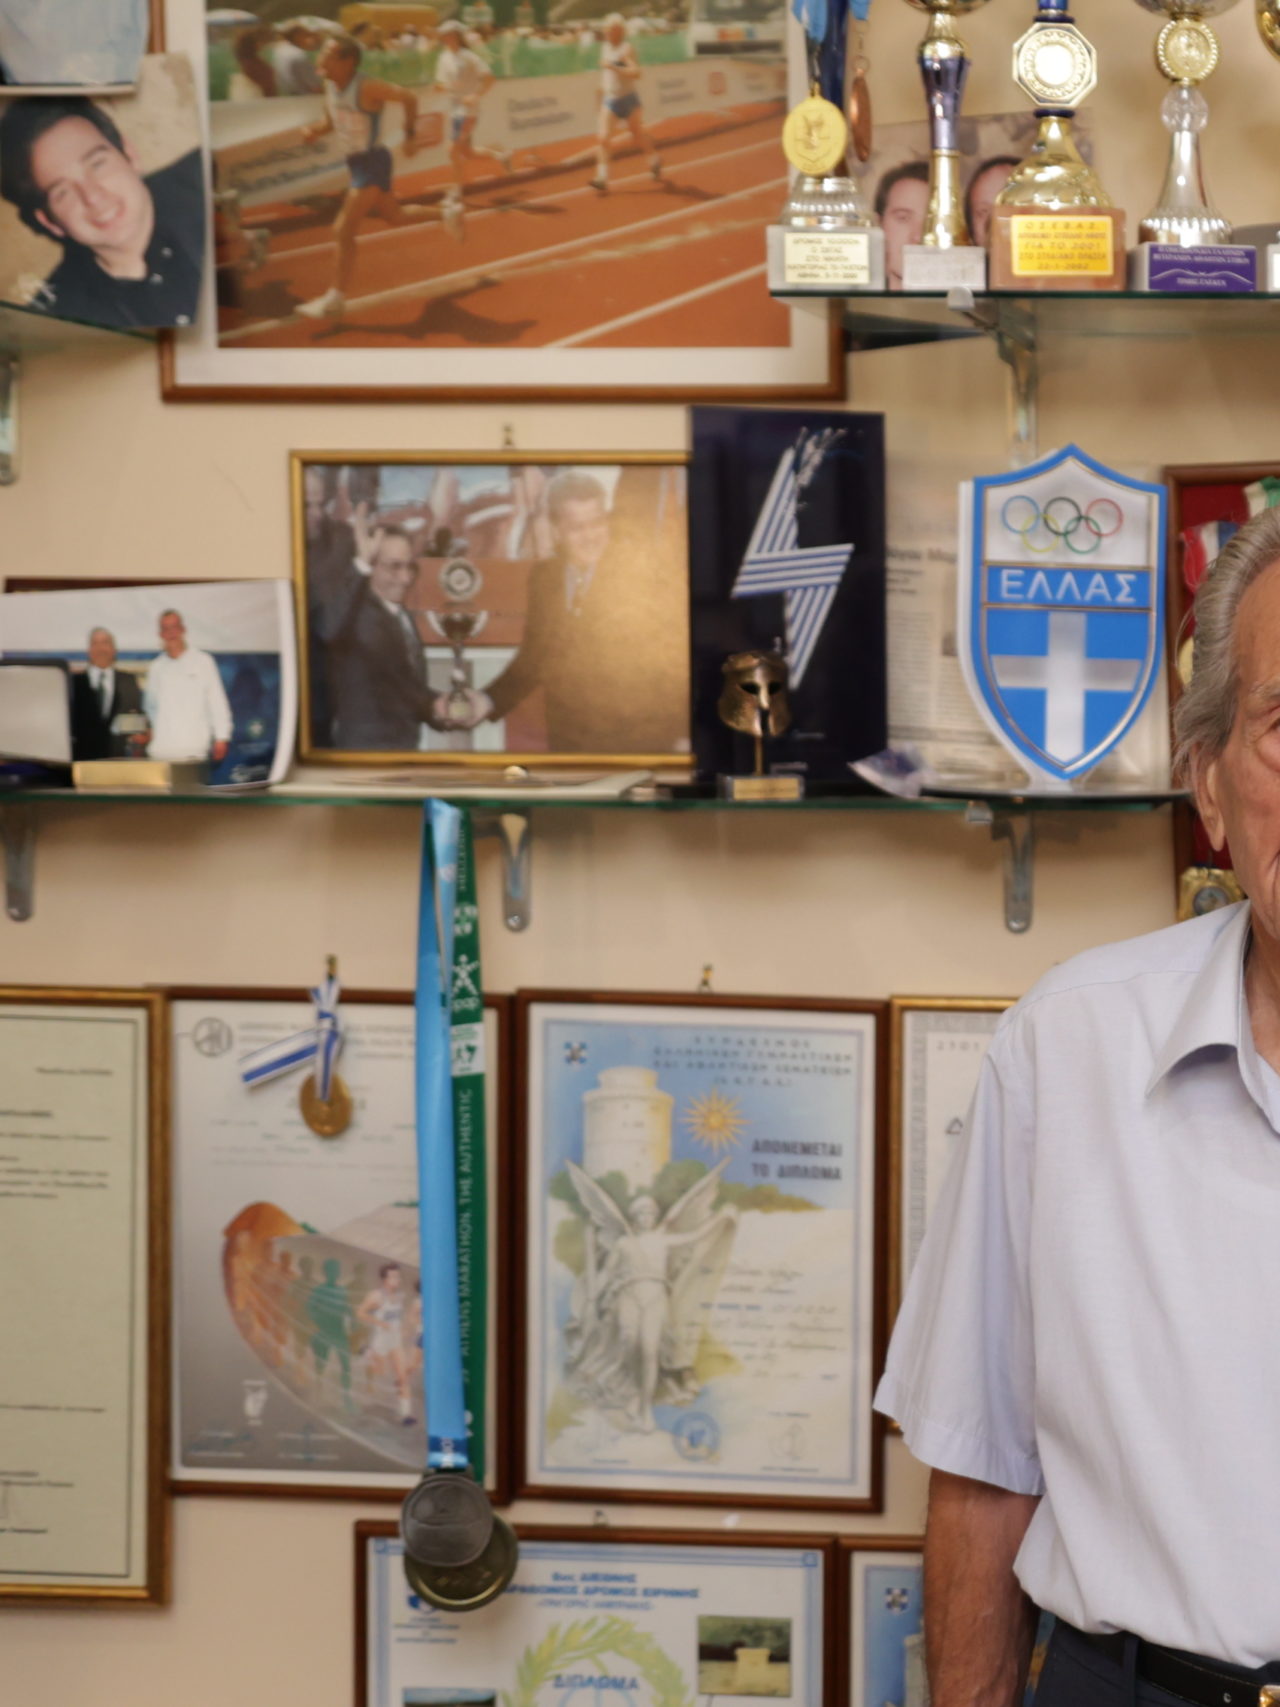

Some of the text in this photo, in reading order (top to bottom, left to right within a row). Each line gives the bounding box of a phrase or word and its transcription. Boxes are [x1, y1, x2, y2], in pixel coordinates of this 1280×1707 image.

[1000, 569, 1138, 604] ΕΛΛΑΣ
[459, 1089, 474, 1174] AUTHENTIC
[751, 1138, 843, 1157] ΑΠΟΝΕΜΕΤΑΙ
[751, 1162, 842, 1181] ΤΟ ΔΙΠΛΩΜΑ
[459, 1177, 473, 1205] THE
[554, 1673, 640, 1690] ΔΙΠΛΩΜΑ
